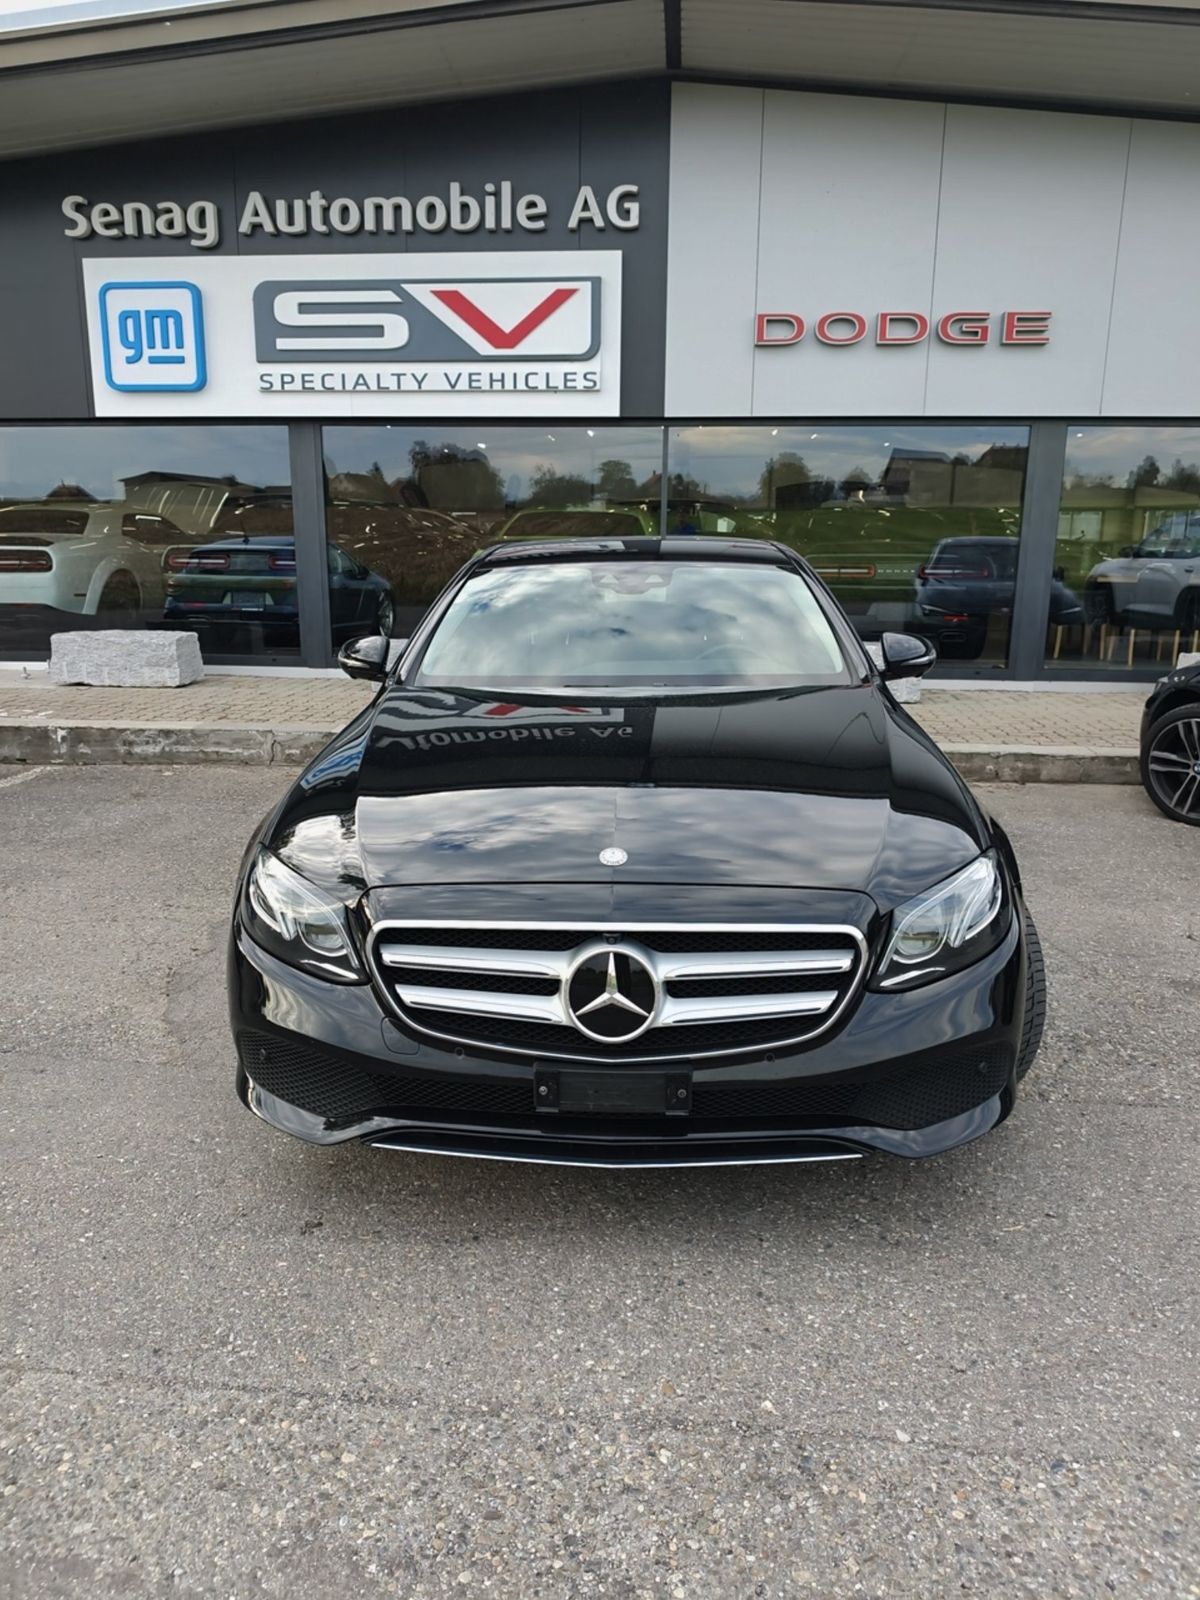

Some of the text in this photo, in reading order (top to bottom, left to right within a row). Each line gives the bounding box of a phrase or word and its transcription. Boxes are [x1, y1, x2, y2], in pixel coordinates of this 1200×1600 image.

[61, 180, 641, 248] Senag Automobile AG
[118, 308, 186, 365] gm
[273, 287, 580, 351] SV
[754, 311, 1053, 346] DODGE
[259, 371, 600, 391] SPECIALTY VEHICLES
